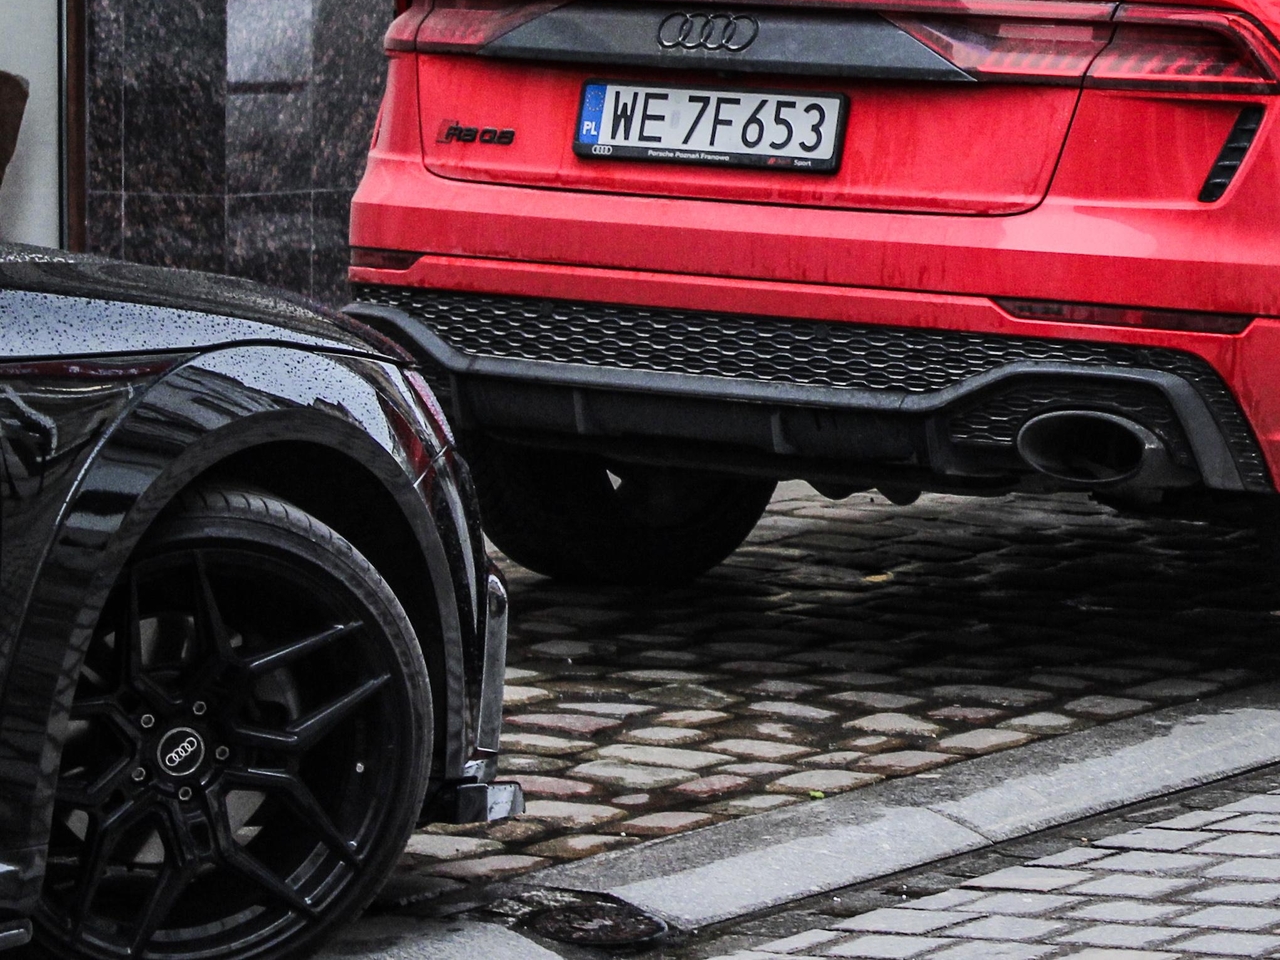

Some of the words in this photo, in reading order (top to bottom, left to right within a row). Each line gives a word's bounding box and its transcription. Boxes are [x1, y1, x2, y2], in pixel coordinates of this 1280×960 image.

[610, 90, 669, 143] WE
[681, 95, 827, 153] 7F653
[583, 121, 598, 136] PL
[647, 149, 674, 157] Porsche
[675, 151, 700, 159] Poznań
[700, 152, 730, 161] Franowo
[793, 159, 812, 167] Sport
